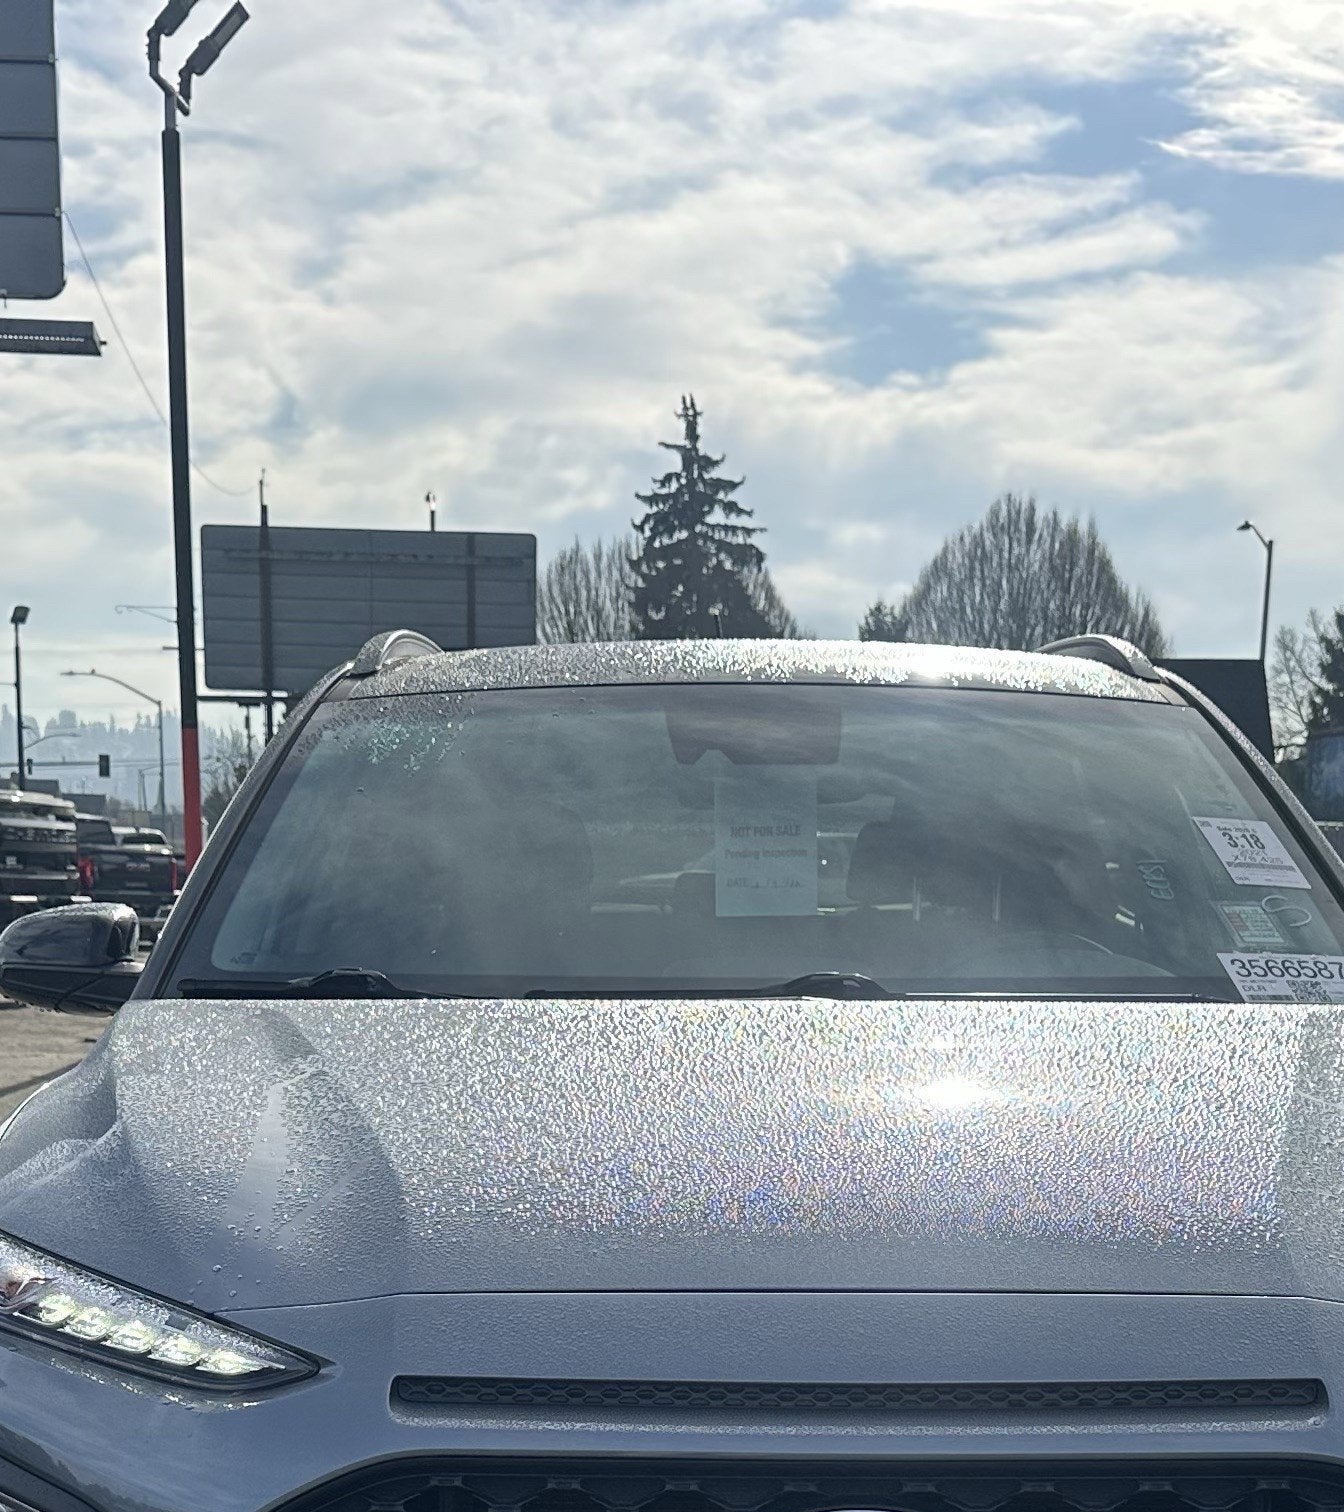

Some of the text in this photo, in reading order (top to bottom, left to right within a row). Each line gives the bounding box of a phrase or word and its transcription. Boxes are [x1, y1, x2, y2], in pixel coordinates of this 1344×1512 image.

[775, 823, 801, 836] SALE
[1221, 831, 1266, 850] 3:18
[1230, 958, 1344, 980] 3566587
